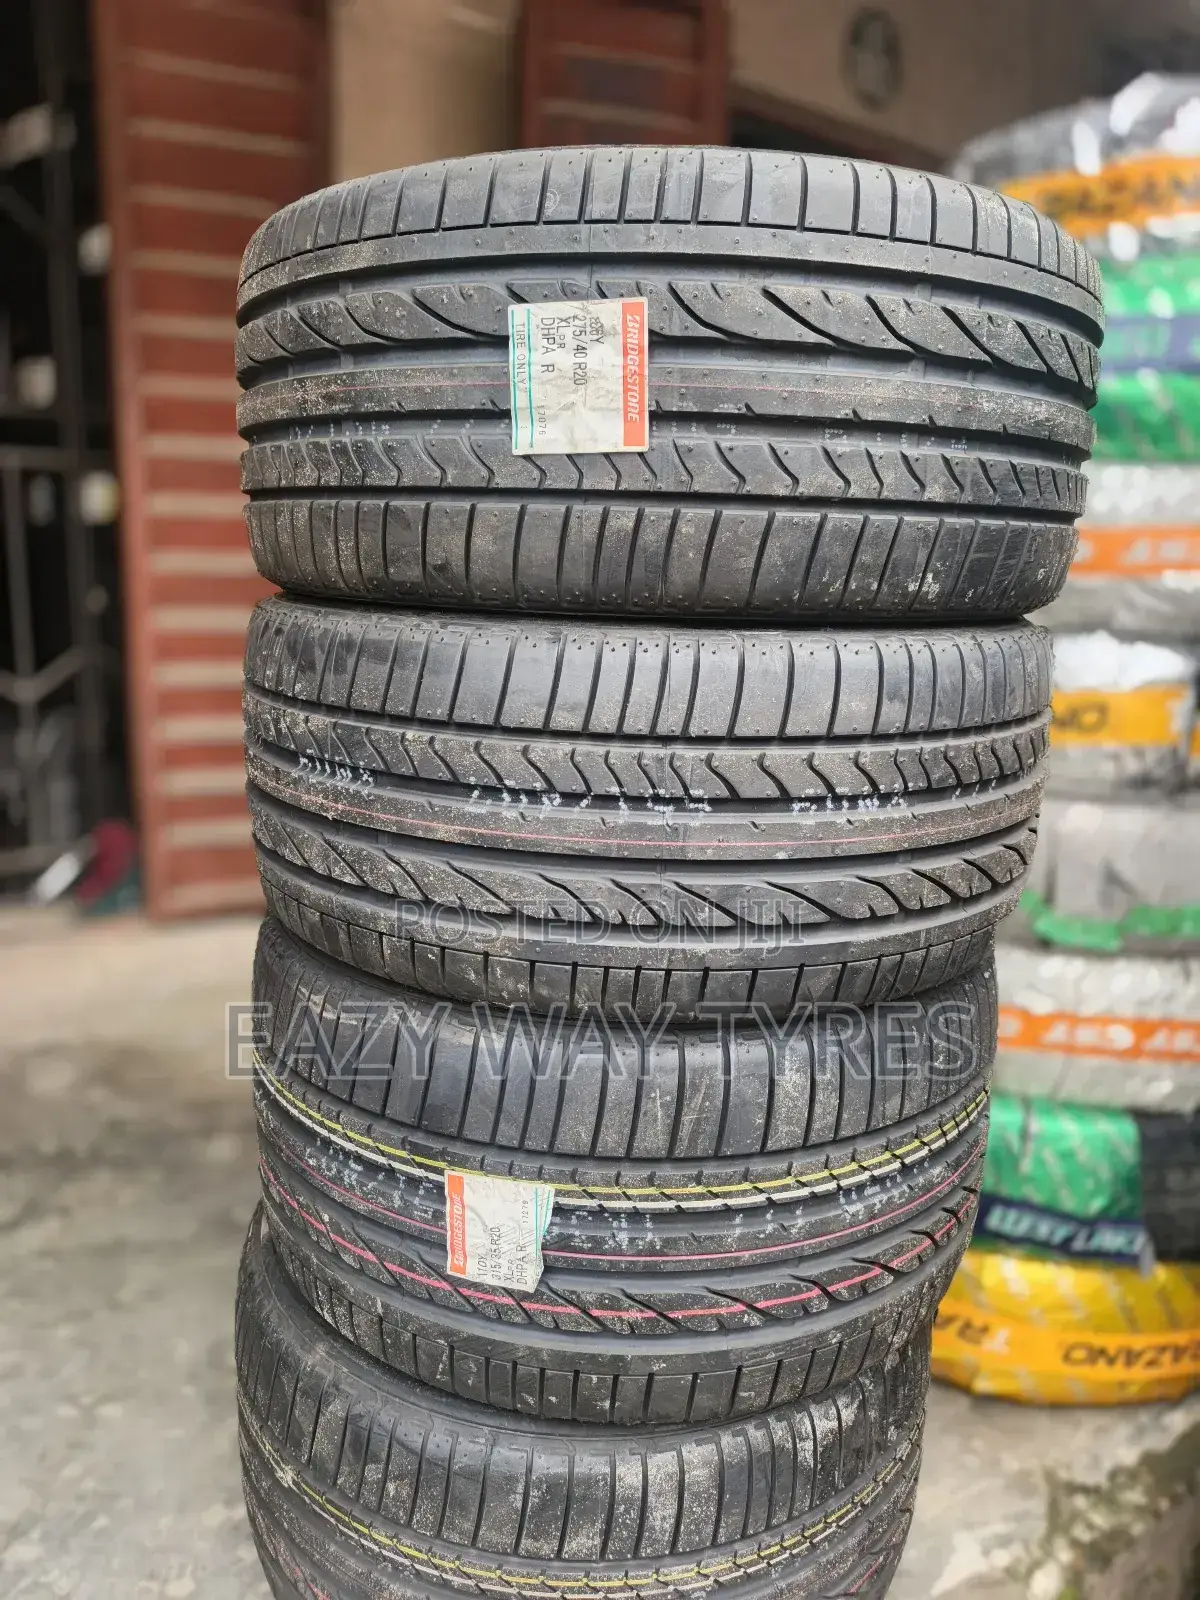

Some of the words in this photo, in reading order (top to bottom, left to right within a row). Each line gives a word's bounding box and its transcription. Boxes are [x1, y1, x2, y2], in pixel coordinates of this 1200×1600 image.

[515, 322, 526, 349] TIRE
[540, 317, 557, 355] DHPA
[541, 363, 555, 374] R
[626, 313, 641, 423] BRIDGESTONE
